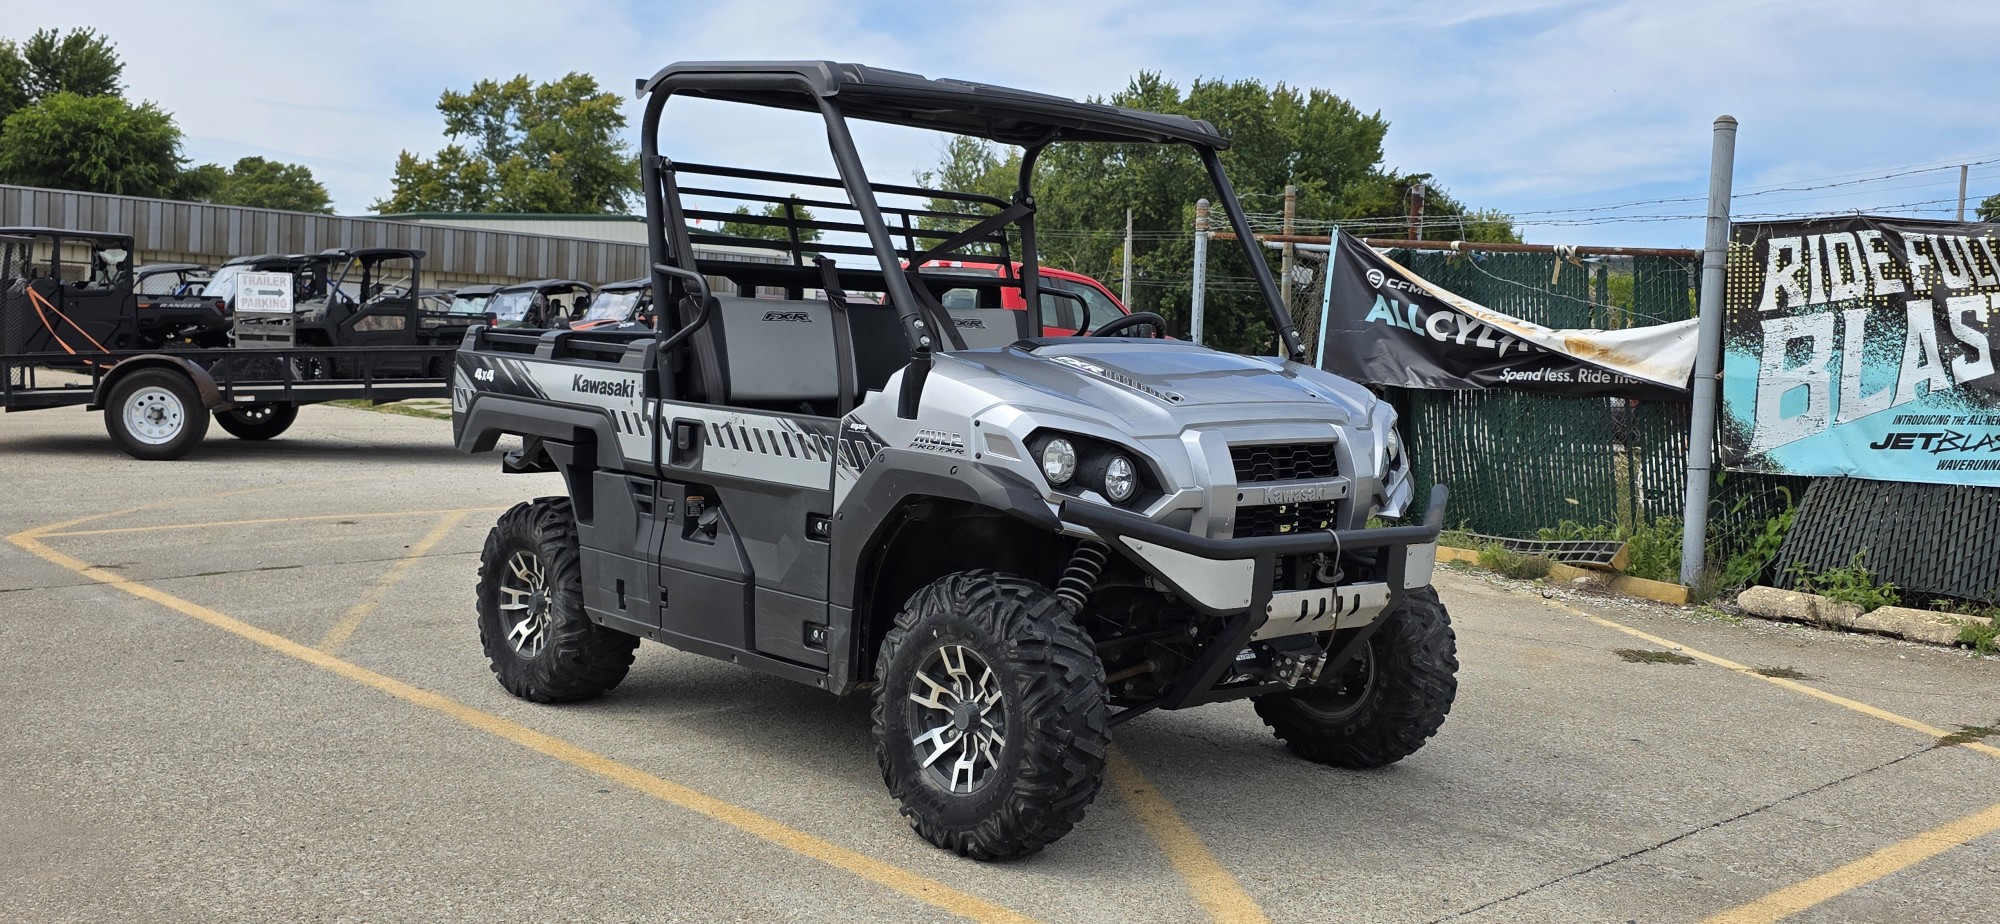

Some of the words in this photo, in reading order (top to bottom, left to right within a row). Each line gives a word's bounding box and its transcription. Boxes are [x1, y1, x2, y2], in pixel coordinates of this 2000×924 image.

[1758, 229, 1906, 312] RIDE
[241, 275, 287, 287] TRAILER
[241, 298, 287, 309] PARKING
[762, 310, 812, 323] FXR
[951, 317, 987, 330] XR
[474, 367, 495, 382] 4x4
[1499, 367, 1544, 383] Spend
[1544, 367, 1574, 383] less.
[1578, 368, 1611, 384] Ride
[572, 373, 636, 399] Kawasaki
[1892, 414, 1951, 426] INTRODUCING
[1951, 415, 1968, 426] THE
[912, 428, 964, 448] MULE
[1936, 459, 2000, 471] WAVERUNN
[1264, 483, 1326, 505] Kawasaki
